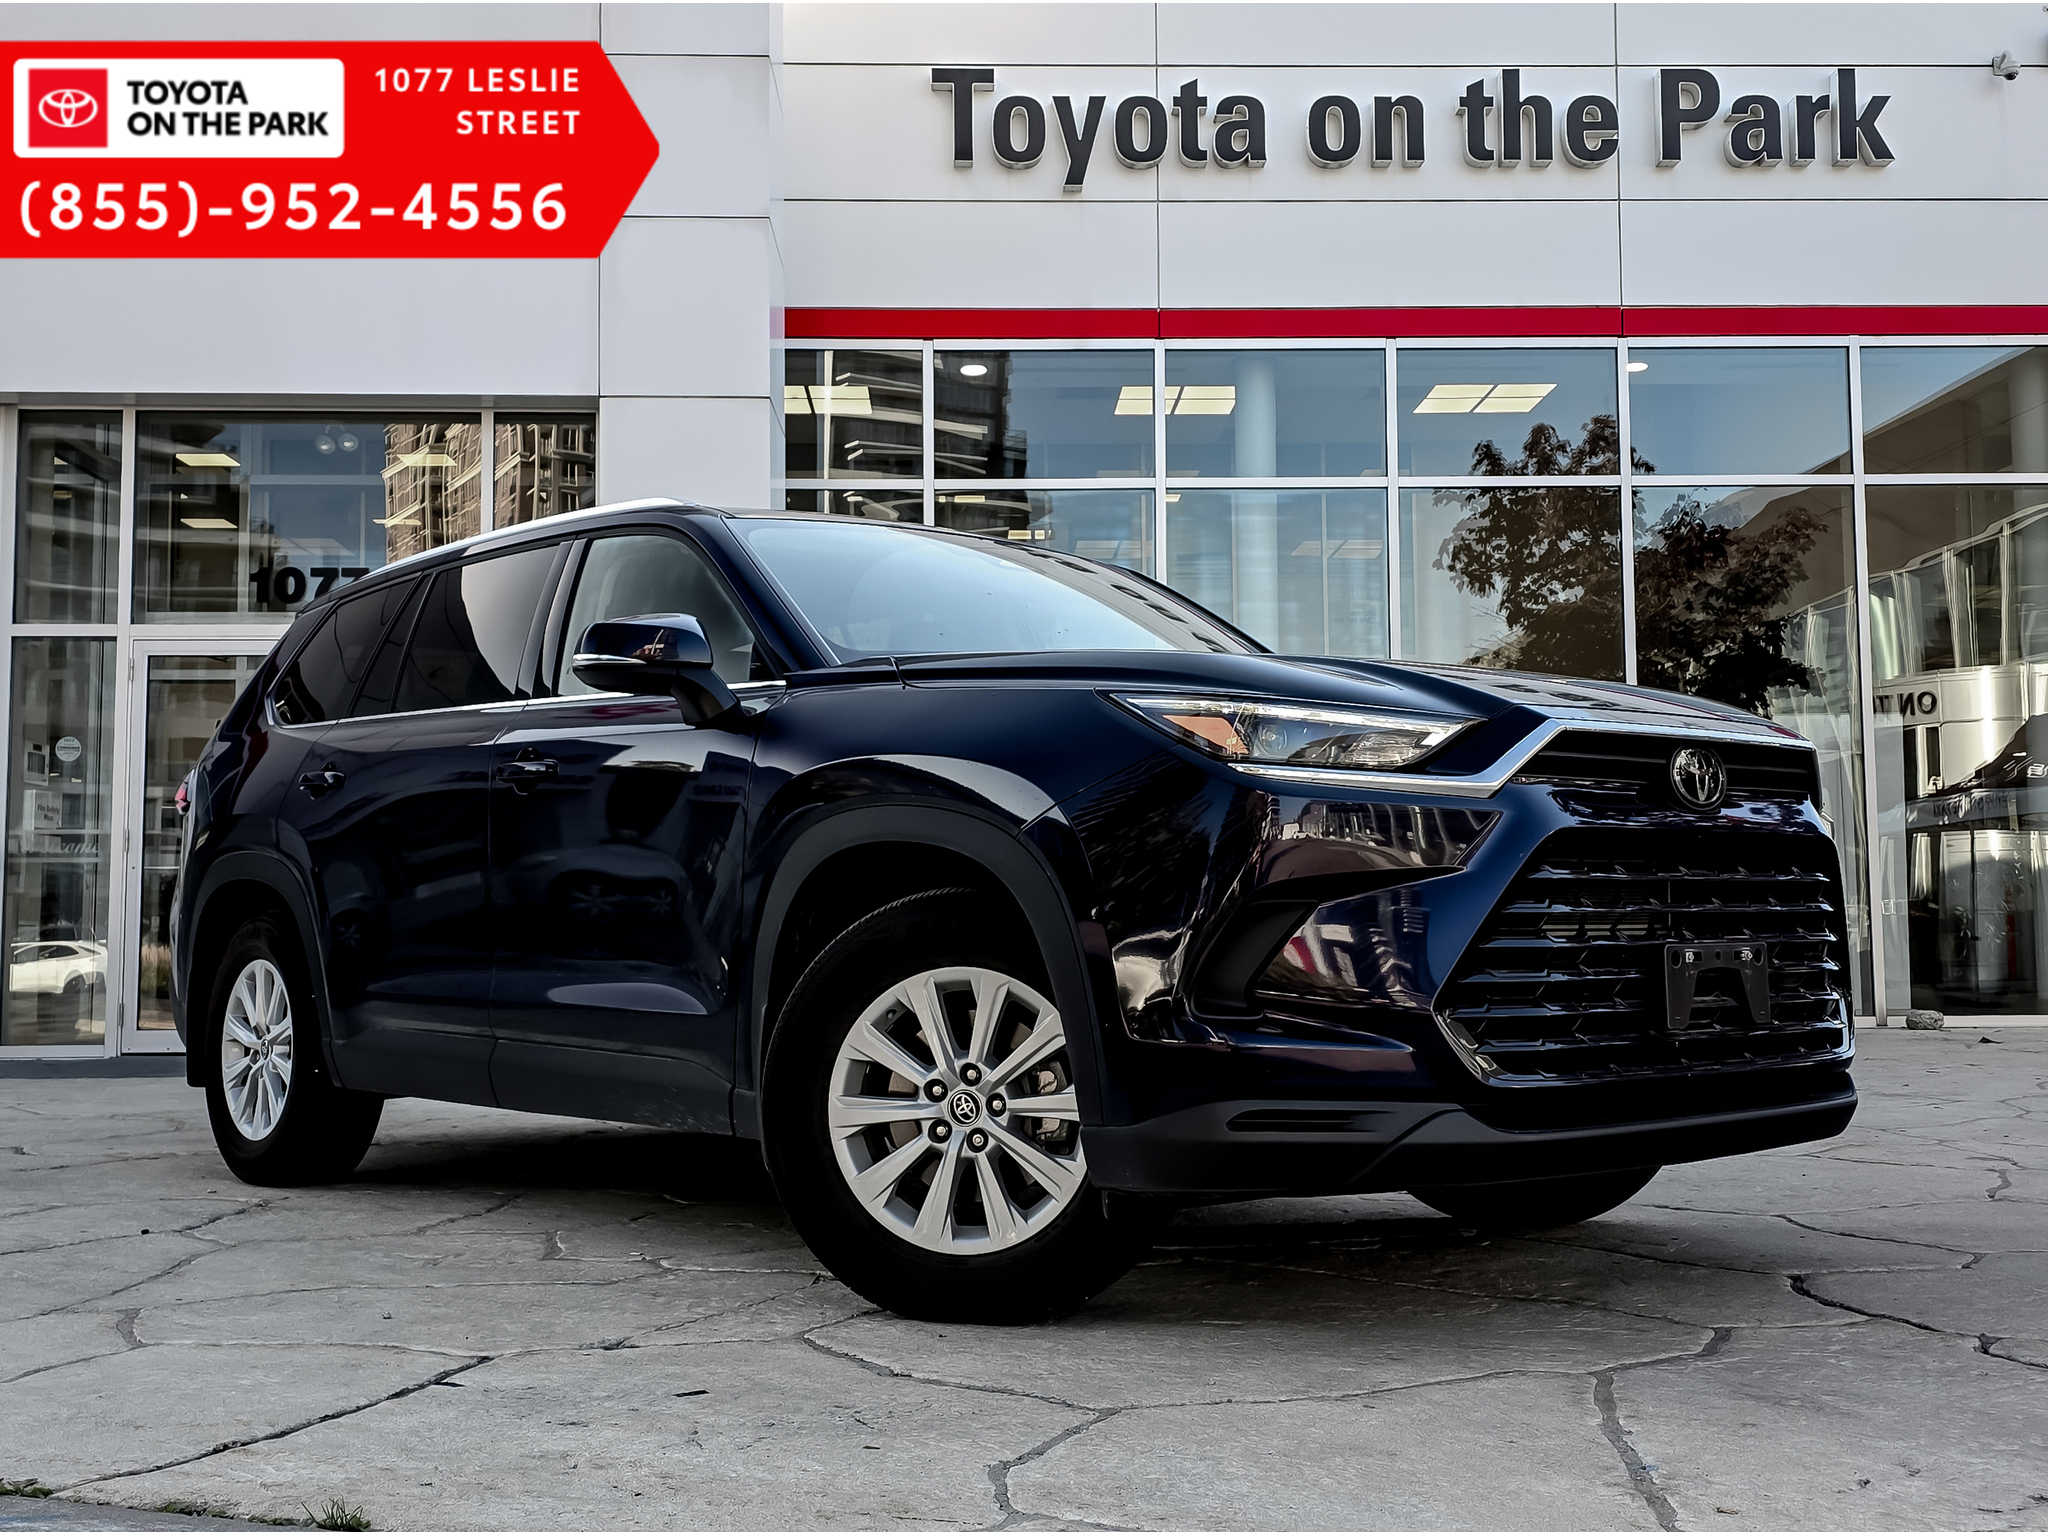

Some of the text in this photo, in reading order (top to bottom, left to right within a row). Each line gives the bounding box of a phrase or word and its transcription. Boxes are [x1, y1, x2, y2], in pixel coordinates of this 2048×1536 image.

[931, 68, 1896, 193] Toyota on the Park
